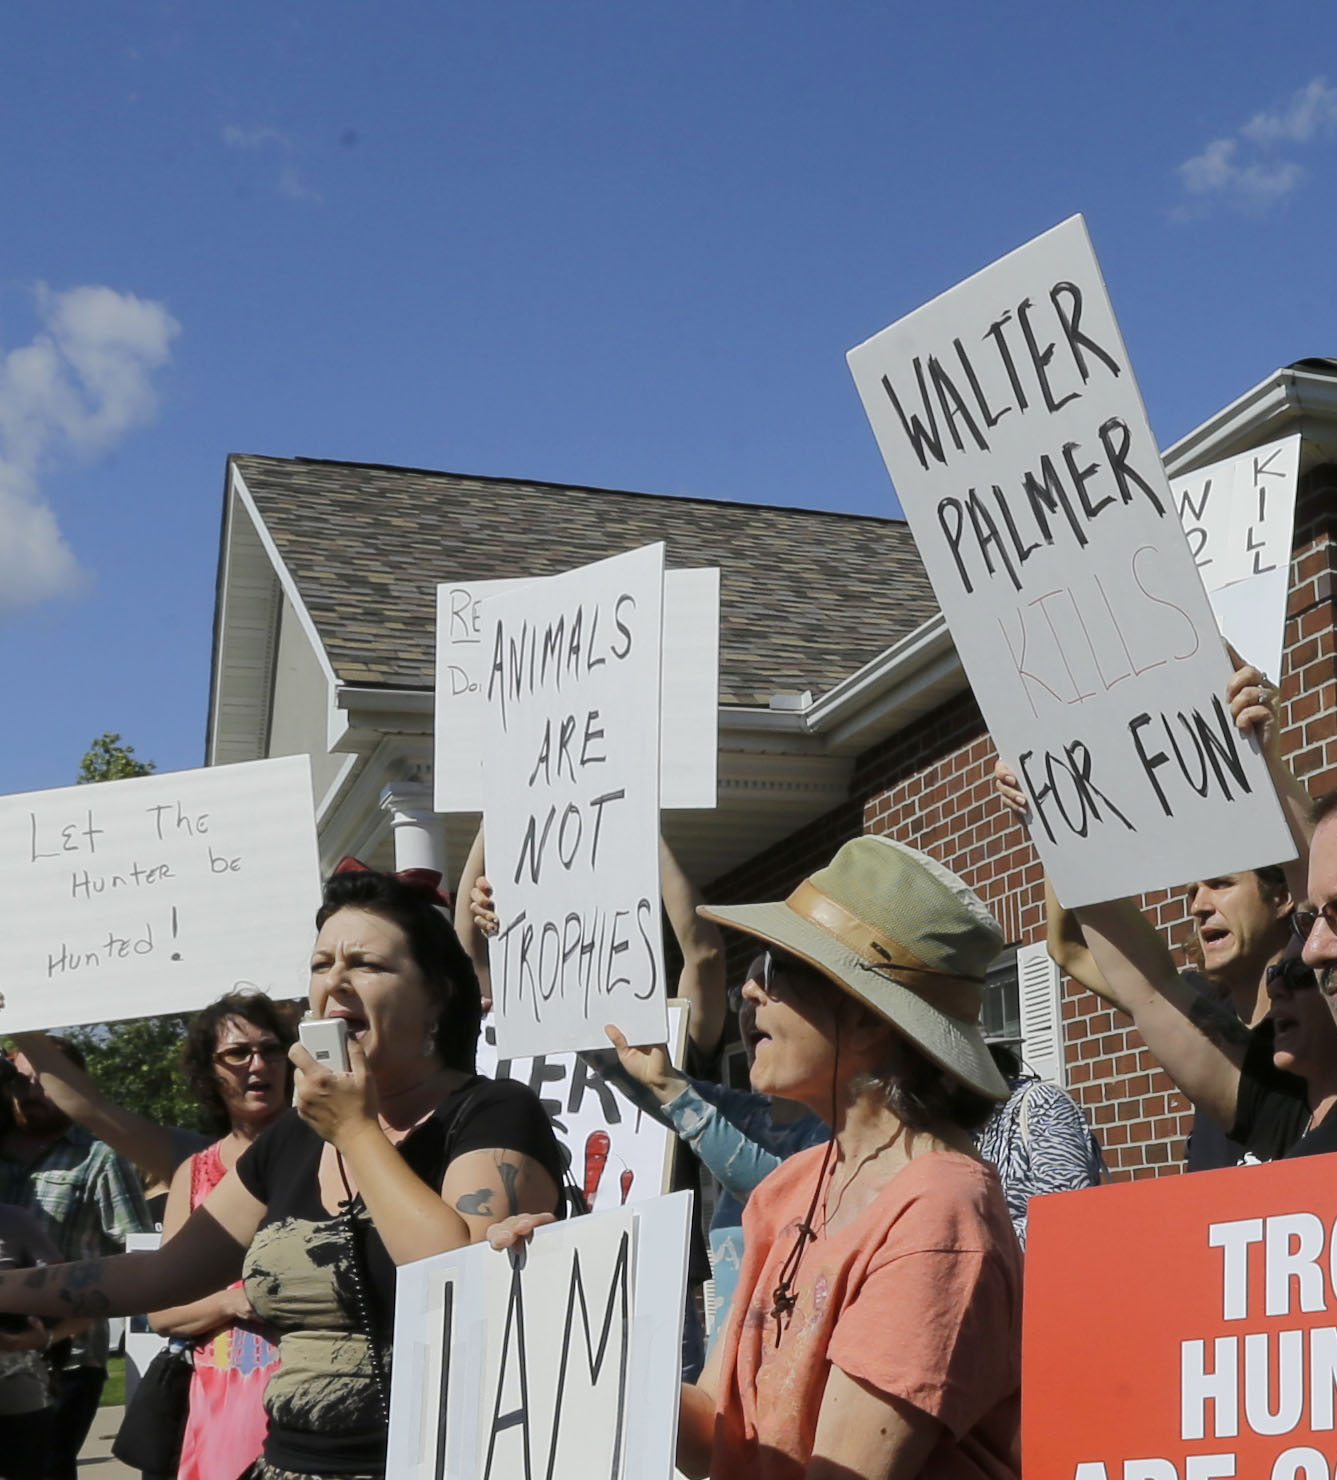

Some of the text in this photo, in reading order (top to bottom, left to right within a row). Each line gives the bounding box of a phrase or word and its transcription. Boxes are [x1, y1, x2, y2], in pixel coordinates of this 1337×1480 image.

[881, 281, 1121, 470] WALTER
[937, 417, 1168, 594] PALMER
[487, 593, 636, 733] ANIMALS
[997, 545, 1199, 719] KILLS
[529, 709, 607, 788] ARE
[1019, 692, 1253, 845] FOR FUN
[513, 788, 626, 886] NOT
[498, 898, 657, 1023] TROPHIES
